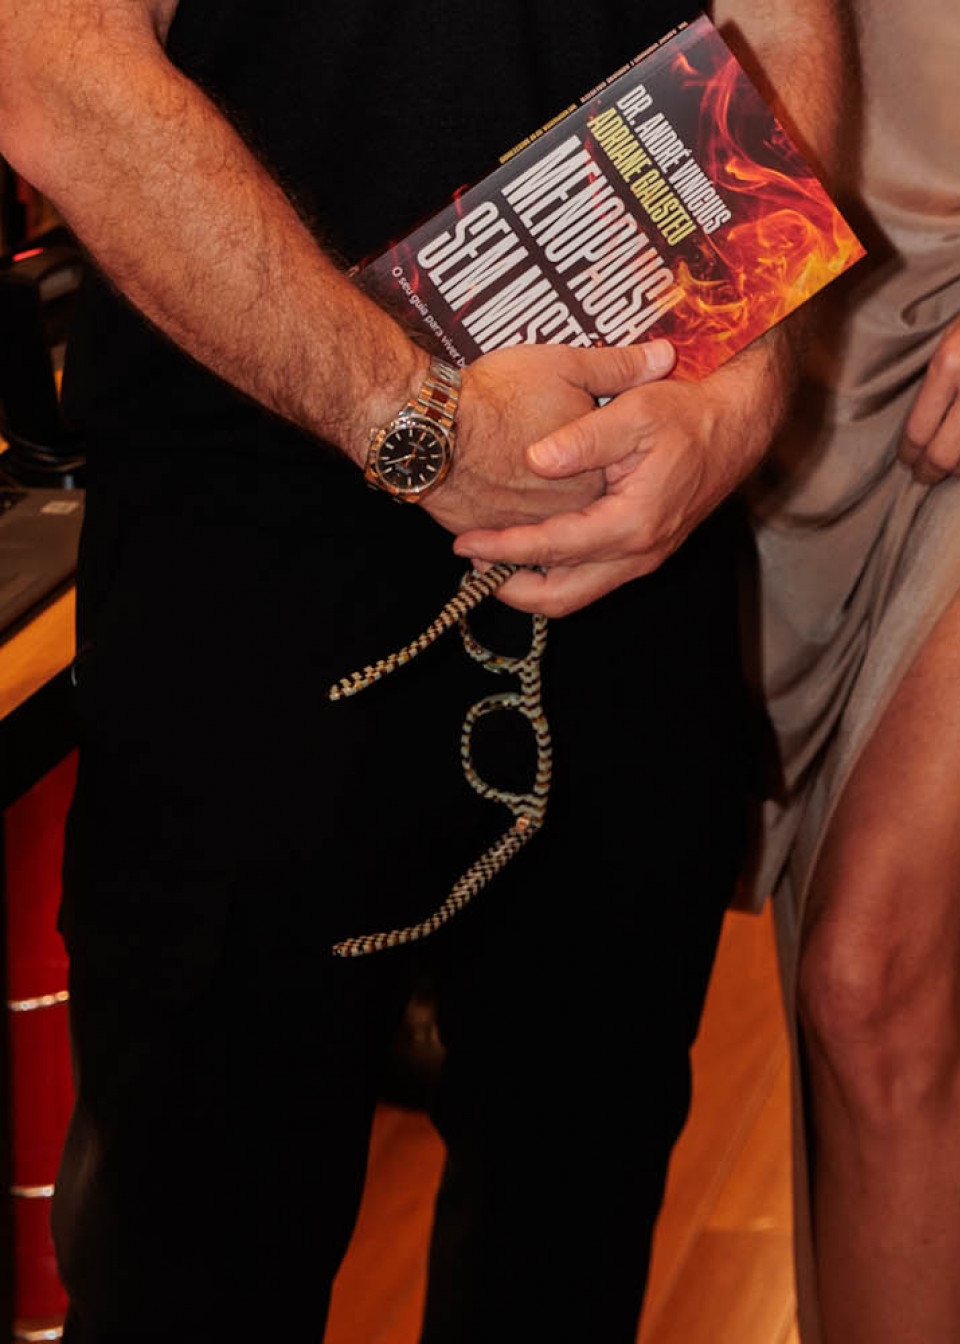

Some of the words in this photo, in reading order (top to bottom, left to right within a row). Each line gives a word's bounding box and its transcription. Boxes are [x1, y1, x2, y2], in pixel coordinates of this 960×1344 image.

[616, 84, 653, 126] DR.
[634, 112, 692, 174] ANDRÉ
[586, 107, 652, 183] ADRIANE
[630, 168, 697, 246] GALISTEU
[417, 201, 529, 311] SEM
[501, 134, 687, 347] MENOPAUSA
[391, 266, 403, 278] O
[399, 277, 413, 295] seu
[410, 295, 429, 315] guia
[425, 316, 443, 337] para
[442, 336, 461, 358] viver
